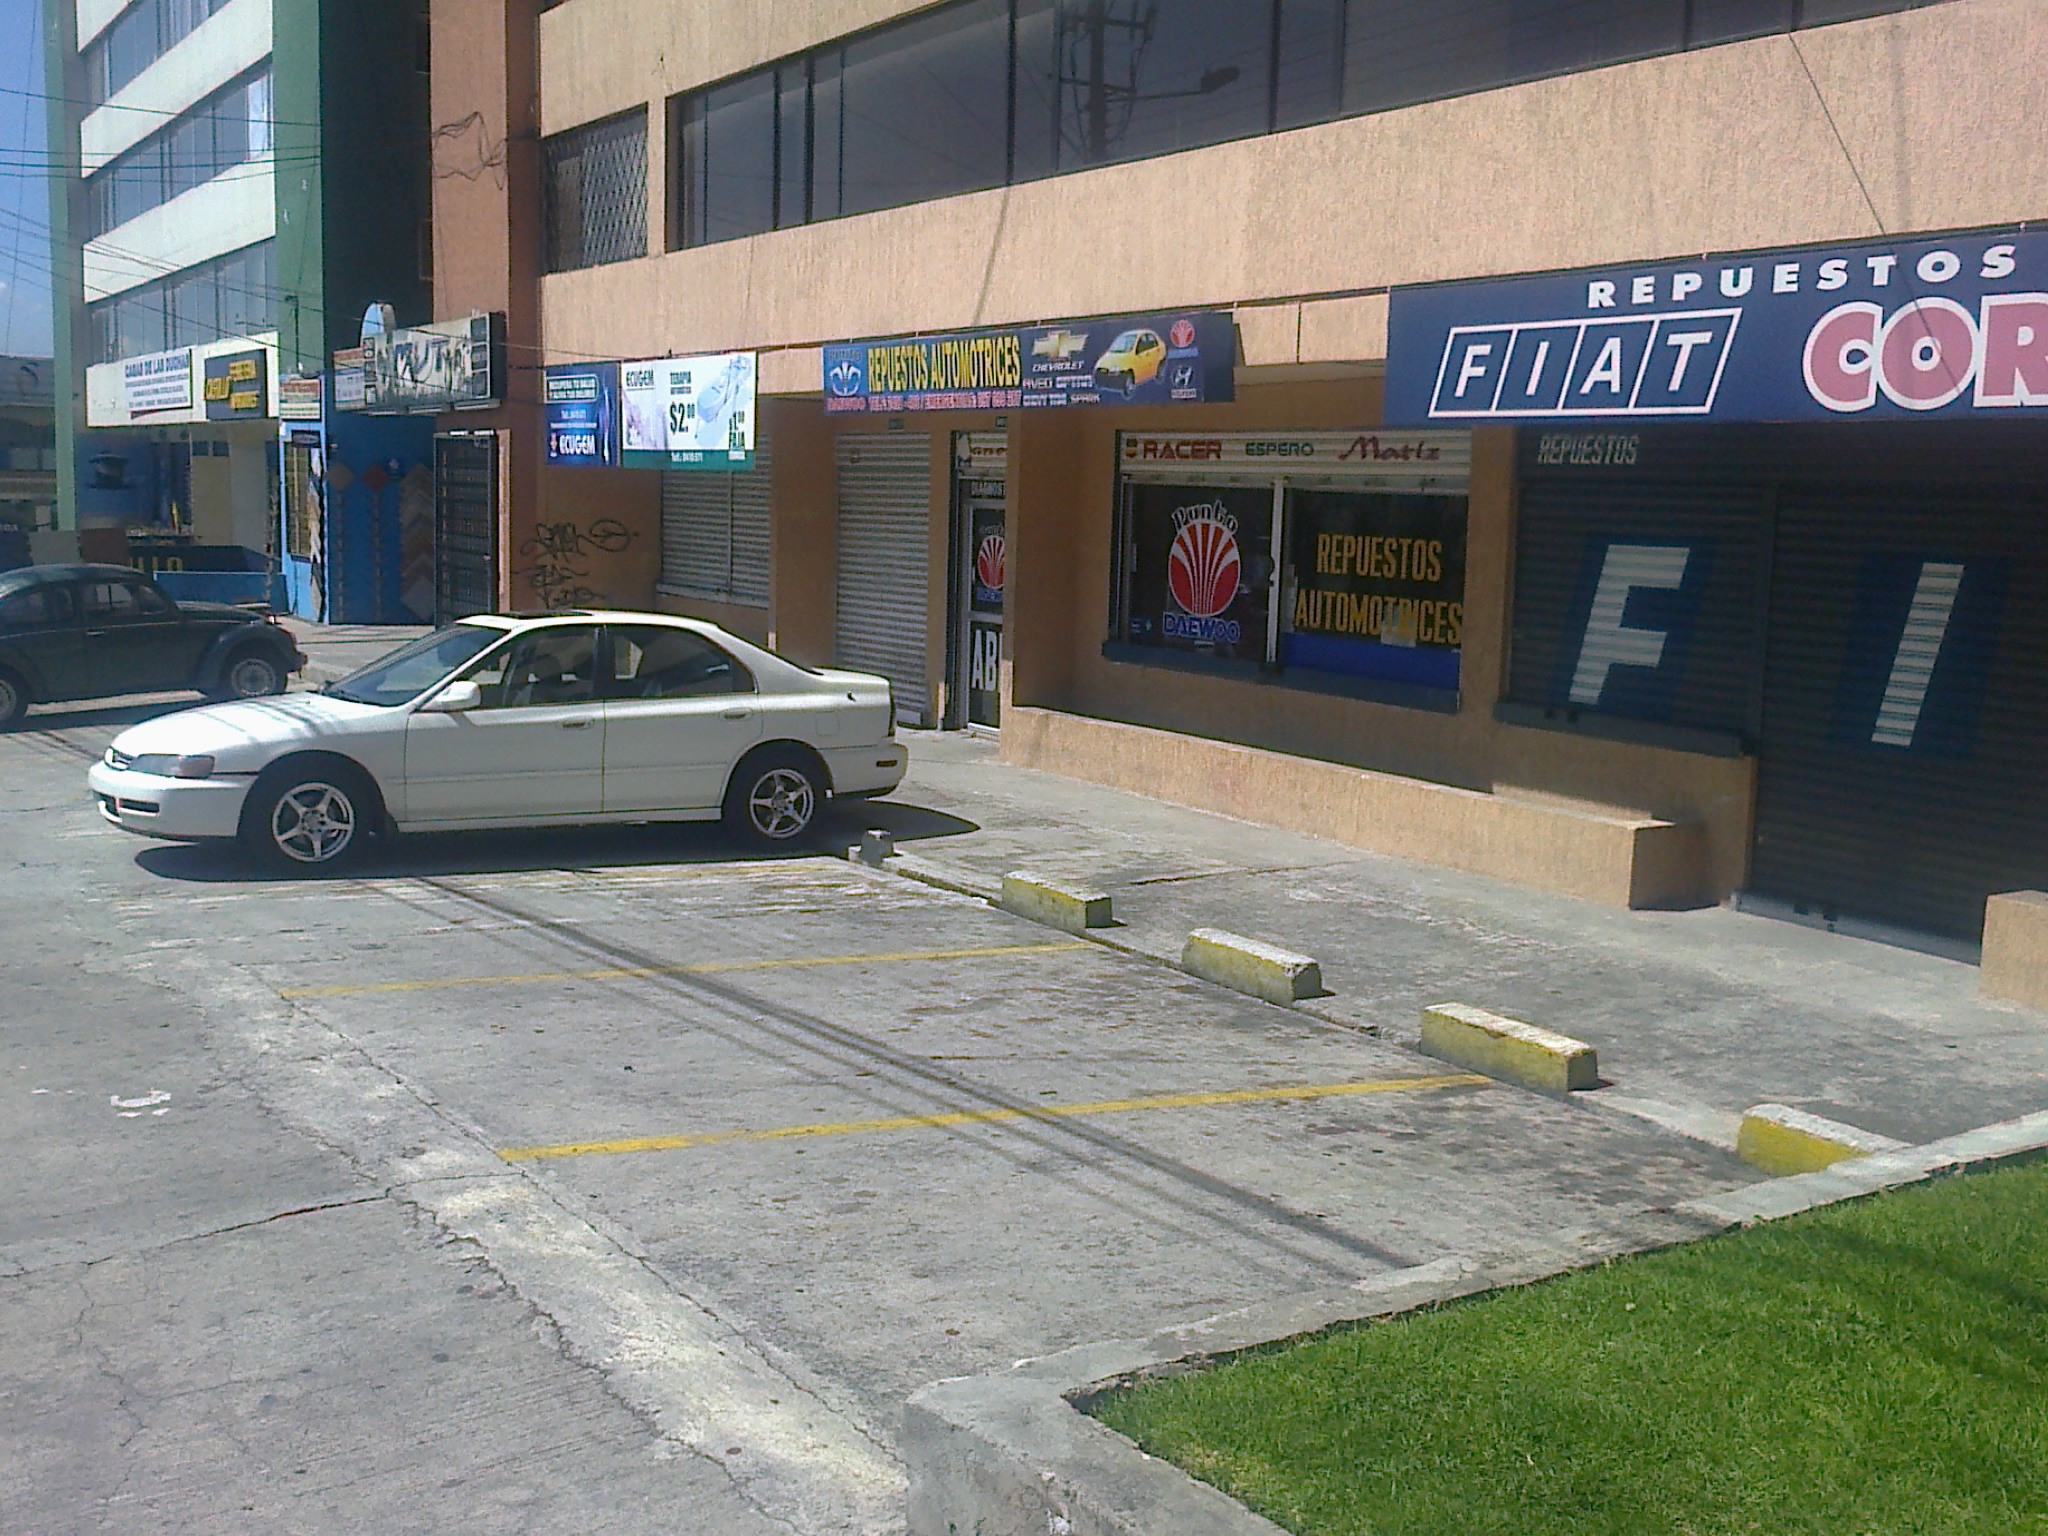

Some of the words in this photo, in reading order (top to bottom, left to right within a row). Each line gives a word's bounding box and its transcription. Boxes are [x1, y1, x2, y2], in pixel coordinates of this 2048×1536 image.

[1588, 245, 2017, 309] REPUESTOS
[868, 343, 929, 392] REPUESTOS
[931, 335, 1021, 390] AUTOMOTRICES
[1032, 360, 1085, 373] CHEVROLET
[1455, 331, 1713, 398] FIAT
[1142, 439, 1222, 460] RACER
[1245, 441, 1314, 457] ESPERO
[1338, 436, 1440, 462] Matiz
[1538, 434, 1639, 465] REPUESTOS
[1171, 500, 1239, 535] Punto
[1316, 533, 1442, 583] REPUESTOS
[1162, 611, 1241, 644] DAEWOO
[1295, 590, 1463, 645] AUTOMOTRICES
